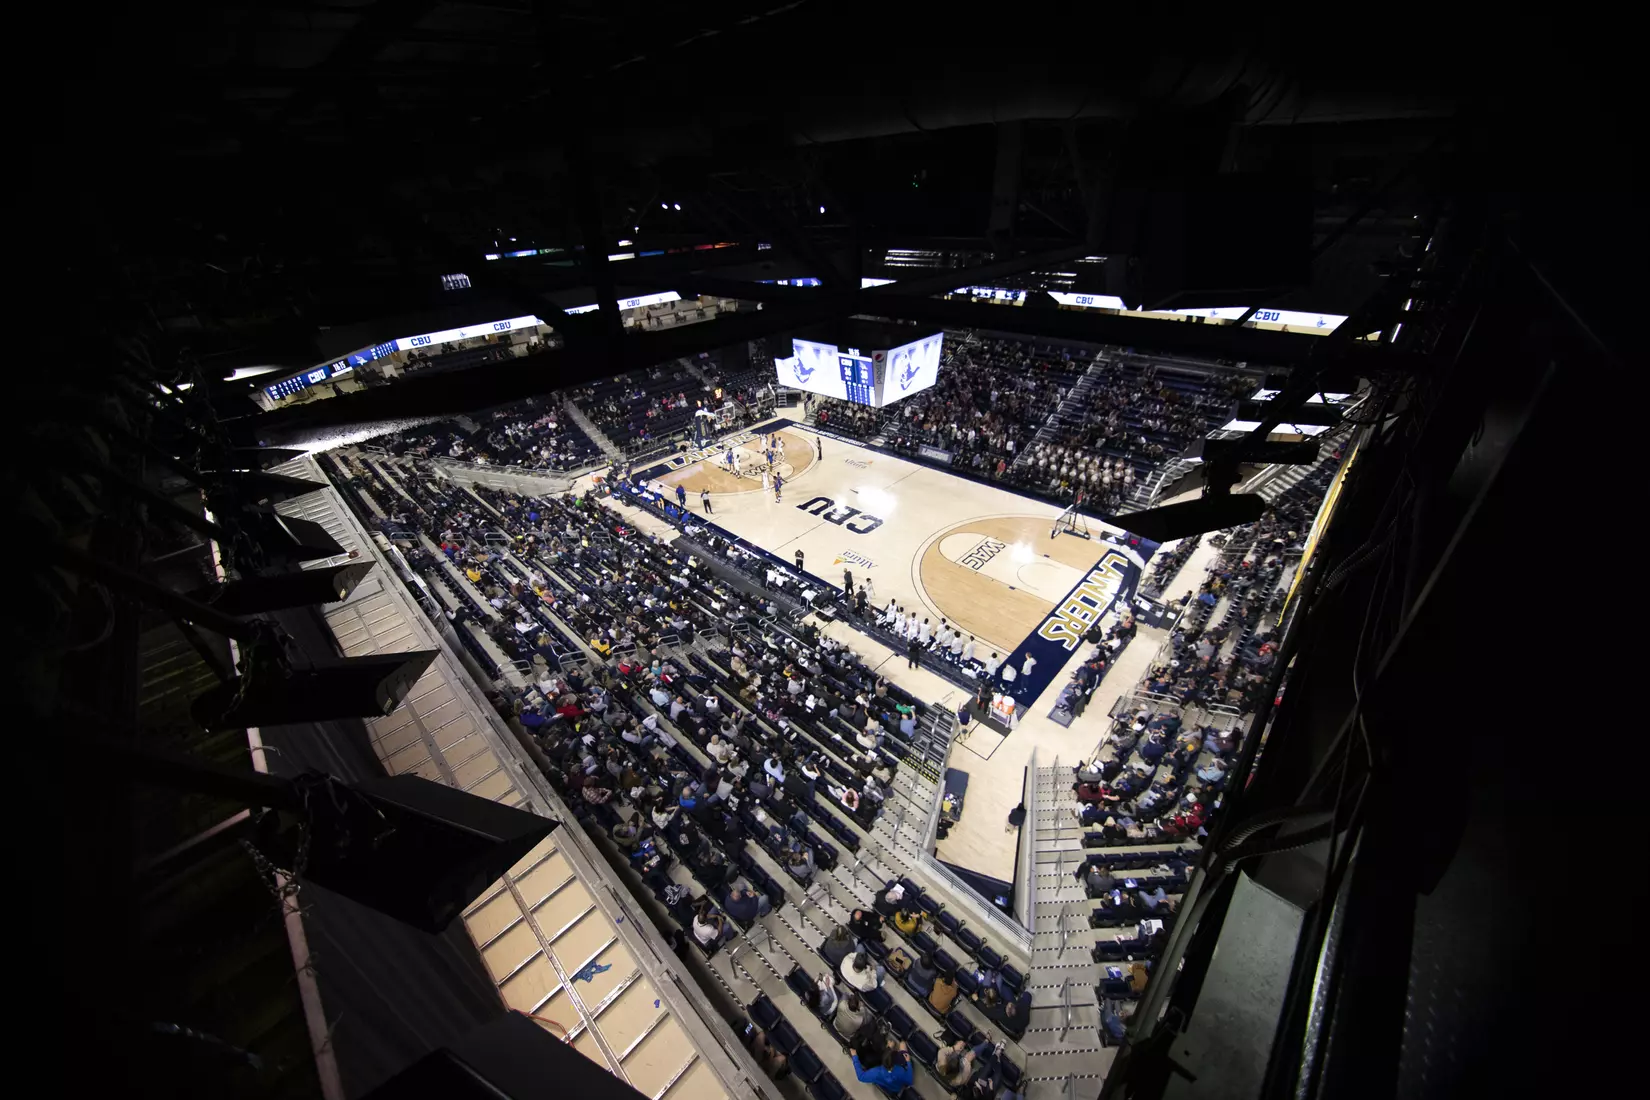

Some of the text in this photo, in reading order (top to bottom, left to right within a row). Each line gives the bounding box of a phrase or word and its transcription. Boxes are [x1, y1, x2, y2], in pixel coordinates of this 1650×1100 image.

[627, 299, 640, 307] CBU
[1075, 296, 1094, 305] CBU
[1255, 310, 1280, 322] CBU
[493, 321, 511, 331] CBU
[411, 336, 431, 347] CBU
[308, 369, 326, 384] CBU
[796, 496, 884, 535] CBU
[843, 550, 878, 569] Altura
[962, 539, 1006, 570] WAC
[1037, 553, 1128, 651] LANCERS
